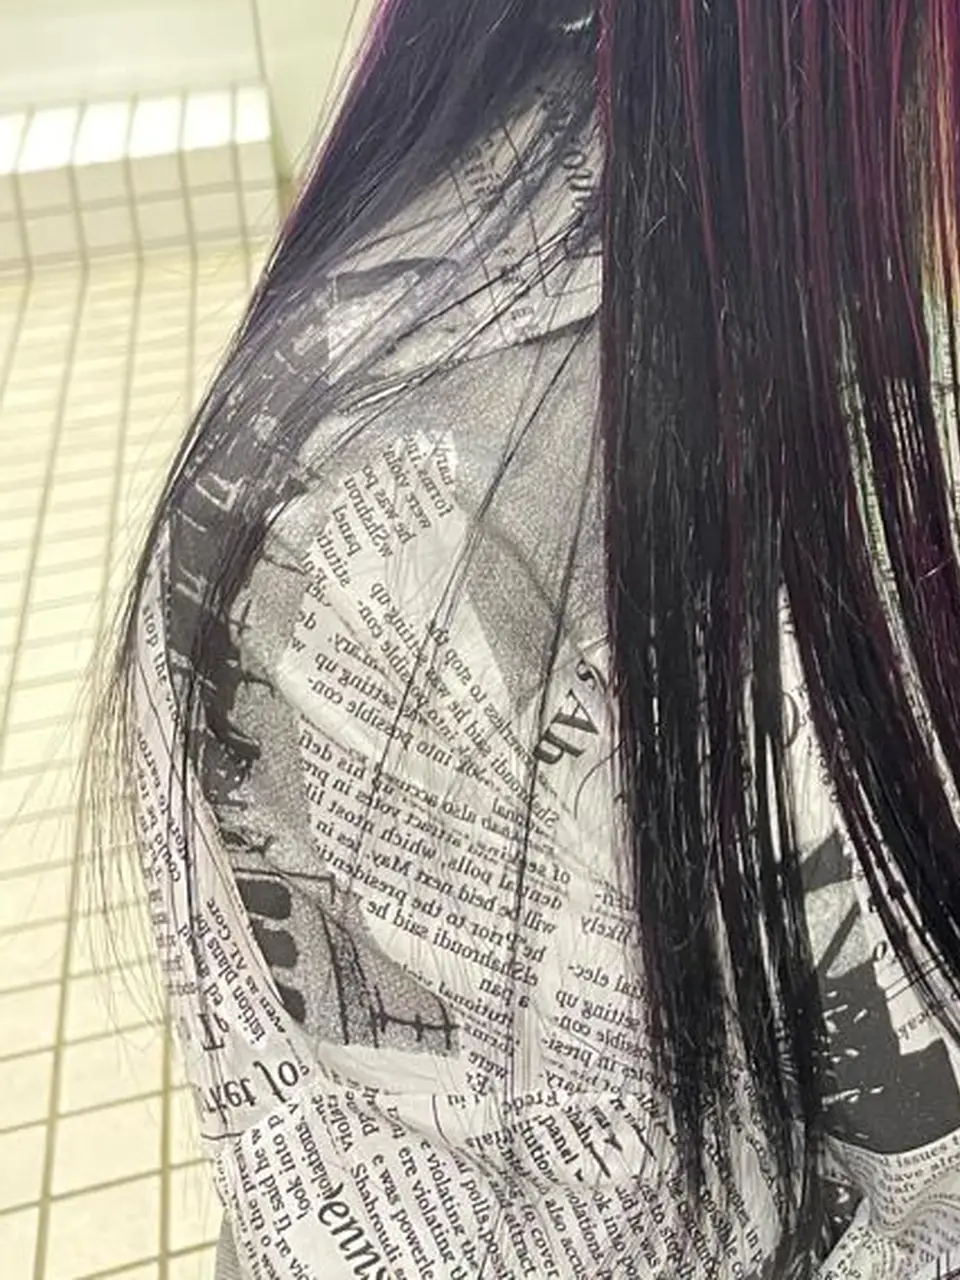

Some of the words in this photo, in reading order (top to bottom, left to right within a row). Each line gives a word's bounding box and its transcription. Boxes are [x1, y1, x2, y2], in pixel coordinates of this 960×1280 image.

[255, 1148, 270, 1174] he
[273, 1134, 296, 1173] into
[538, 1115, 578, 1164] panel
[259, 1174, 284, 1212] said
[380, 1169, 400, 1205] was
[427, 1153, 465, 1236] violating
[350, 1163, 402, 1264] Shahroudi
[412, 1180, 455, 1264] violating
